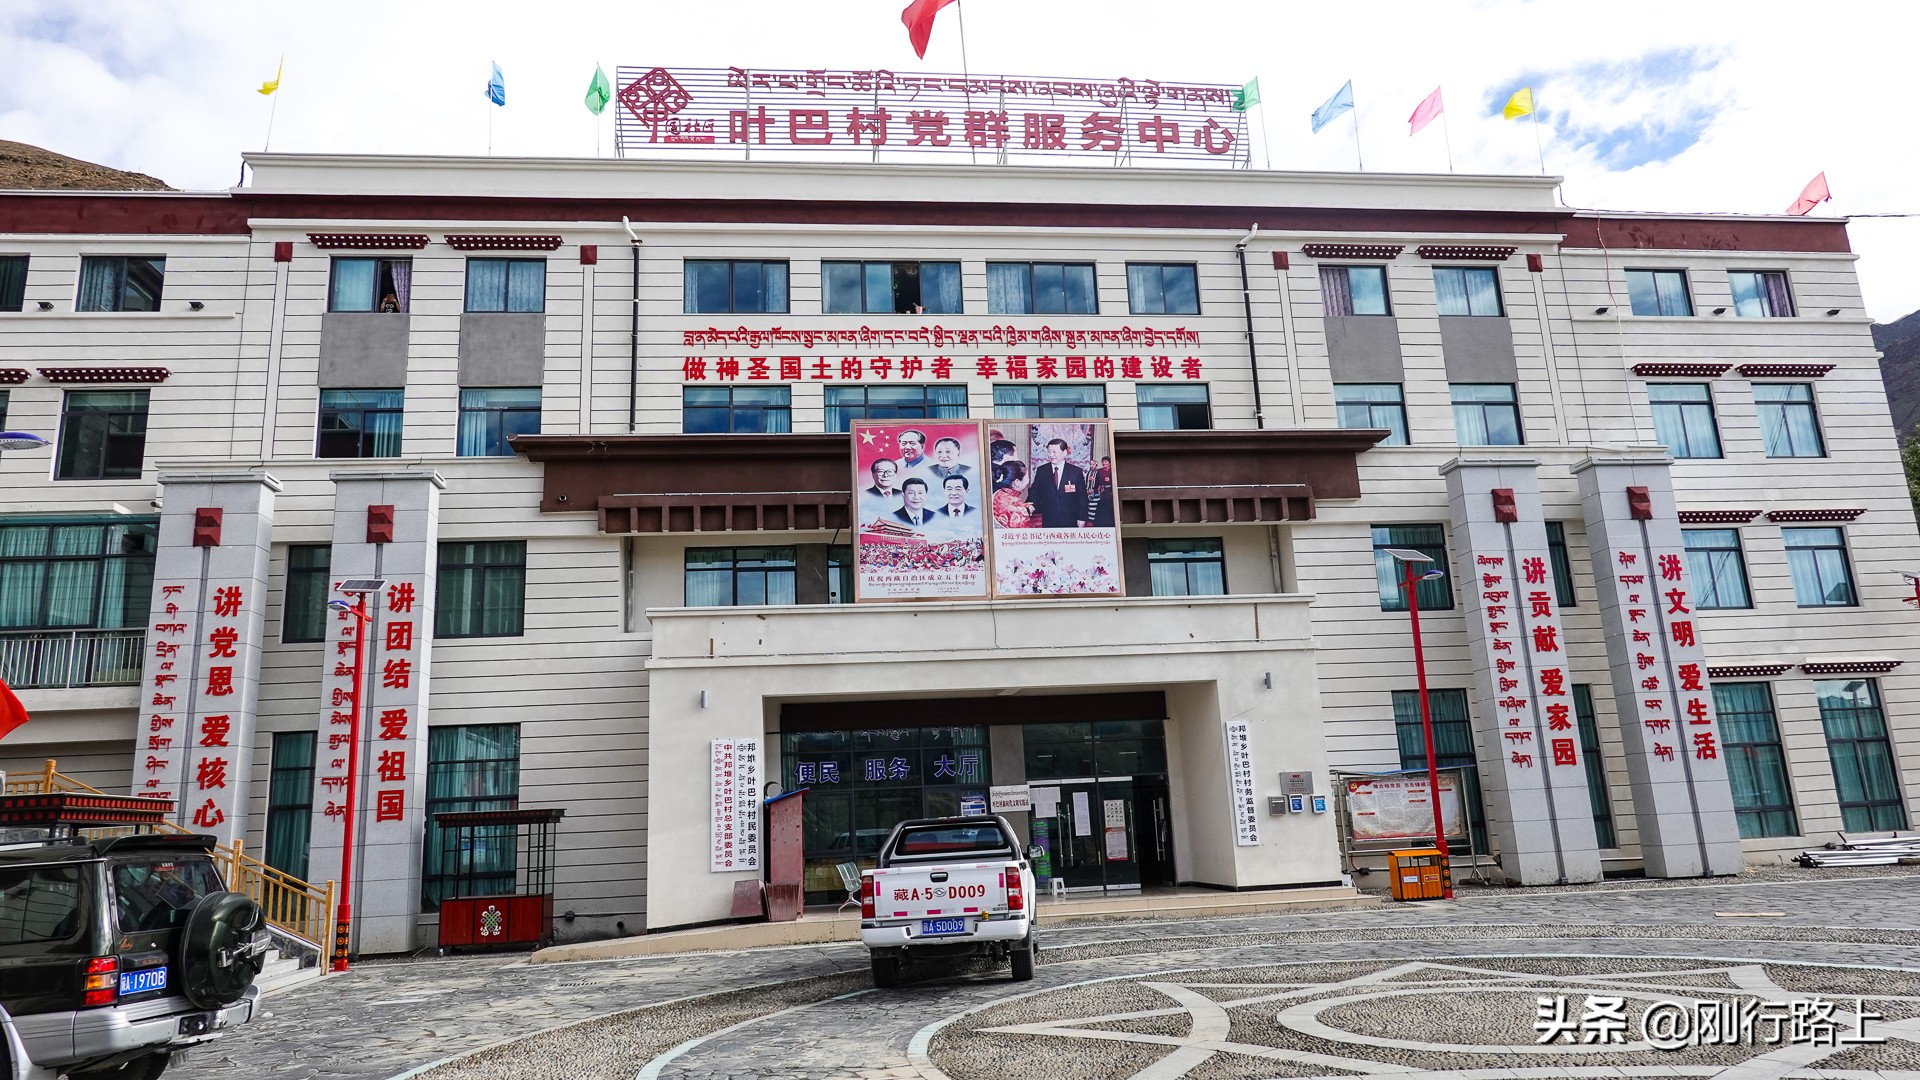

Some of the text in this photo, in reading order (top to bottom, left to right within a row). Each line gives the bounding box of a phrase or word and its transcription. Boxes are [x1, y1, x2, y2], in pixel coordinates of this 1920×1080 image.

[728, 105, 1234, 155] 叶巴村党群服务中心
[682, 355, 1203, 381] 做神圣国土的守护者 幸福家园的建设者
[868, 574, 977, 582] 庆祝西藏自治区成立五十周年
[1001, 531, 1111, 540] 习近平总书记与西藏各族人民心连心
[192, 586, 243, 828] 讲党恩 爱核心
[376, 583, 416, 823] 讲团结 爱祖国
[1522, 557, 1577, 767] 讲贡献 爱家园
[1658, 554, 1717, 760] 讲文明 爱生活
[723, 743, 733, 867] 中共邦堆乡叶巴村总支部委员会
[747, 742, 757, 866] 邦堆乡叶巴村村民委员会
[794, 754, 979, 784] 便民 服务 大厅
[1238, 725, 1258, 842] 邦堆乡叶巴村村务监督委员会
